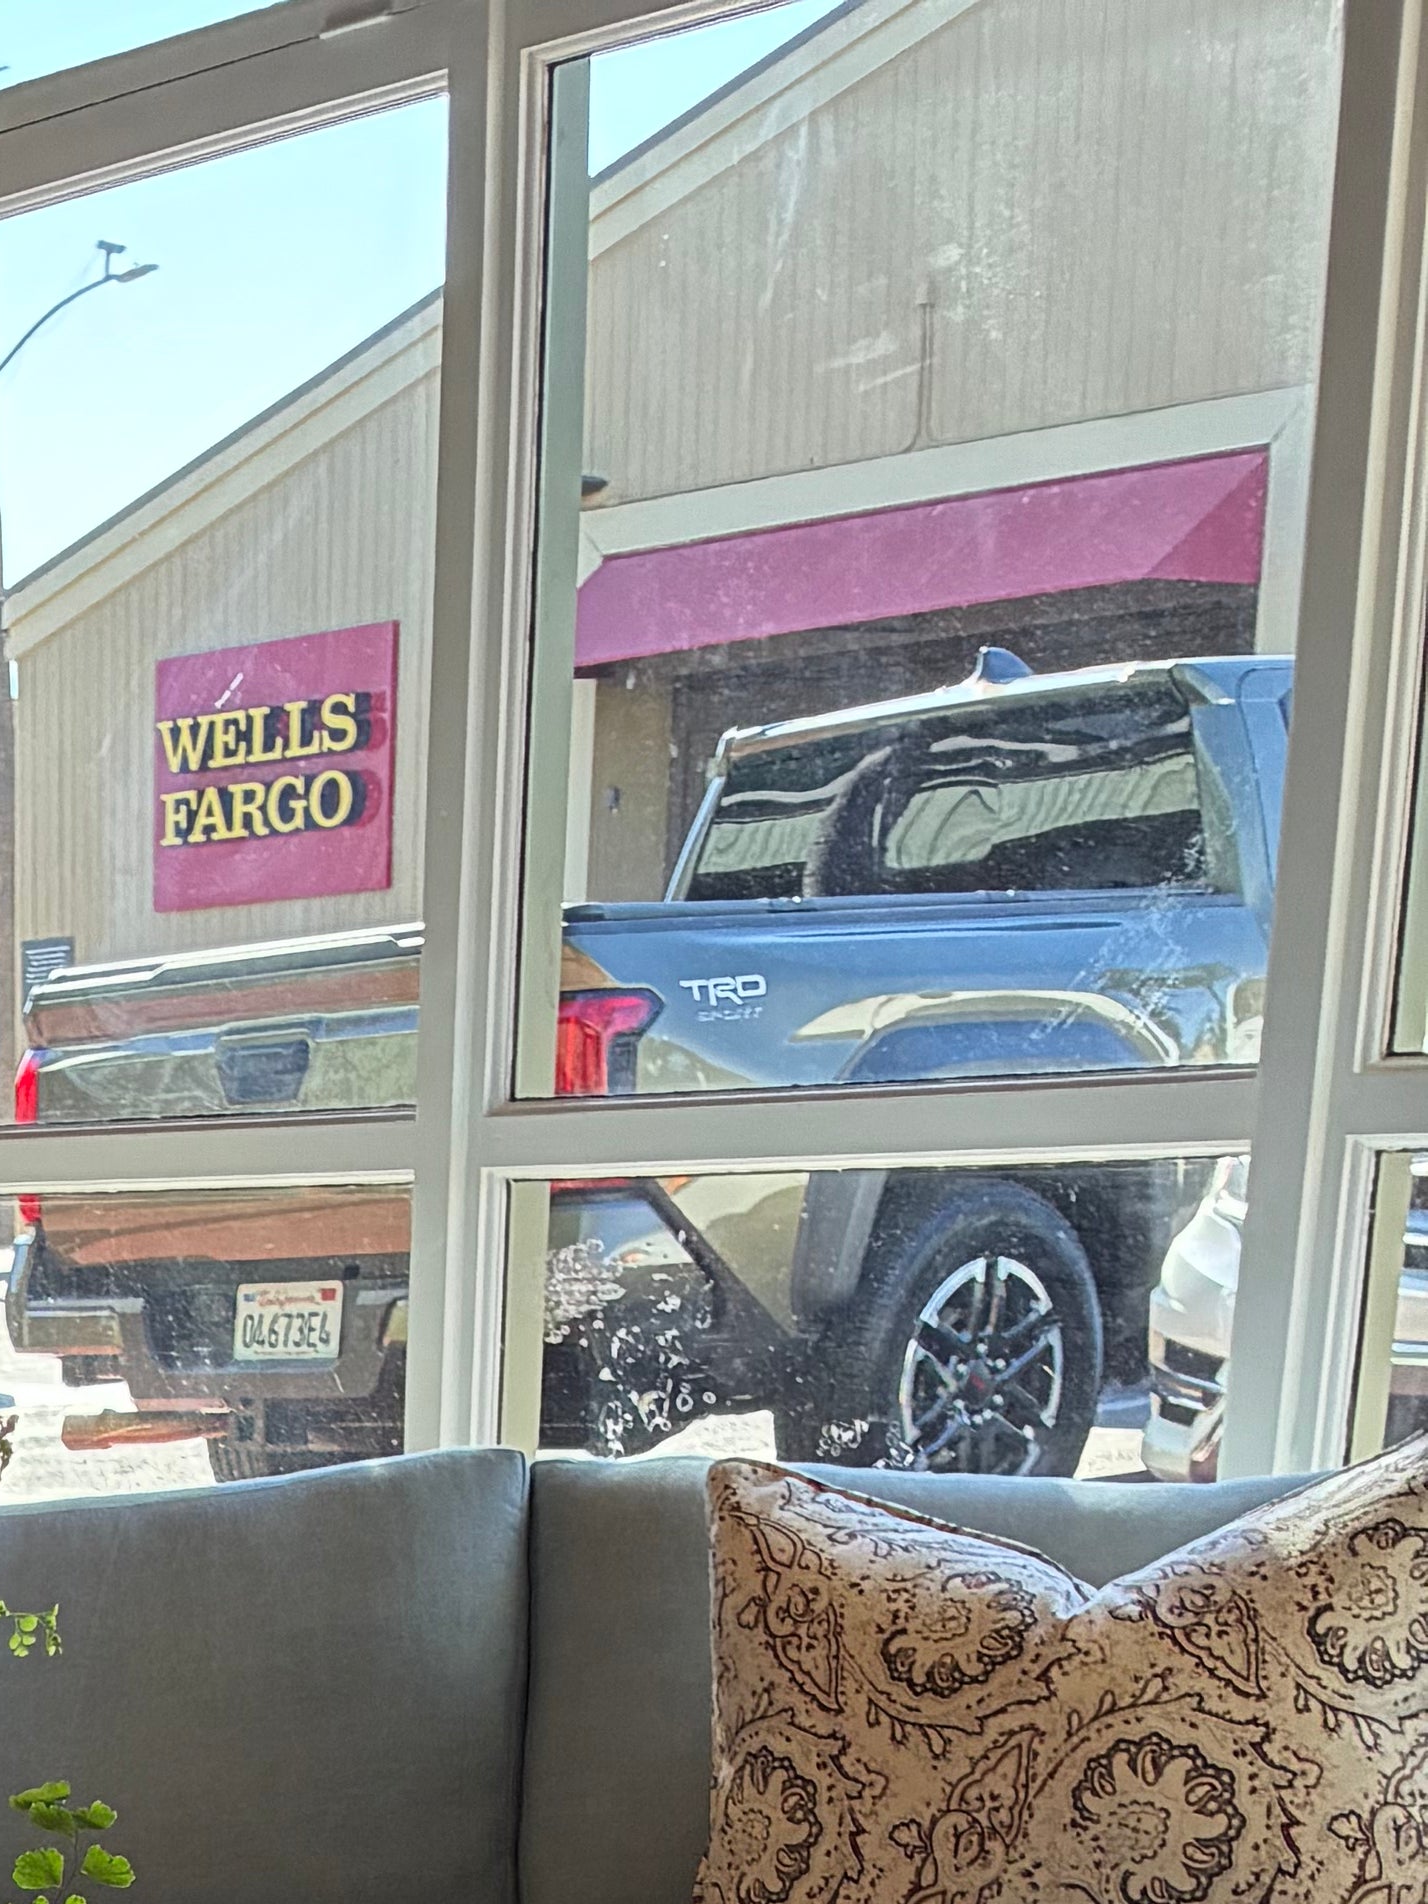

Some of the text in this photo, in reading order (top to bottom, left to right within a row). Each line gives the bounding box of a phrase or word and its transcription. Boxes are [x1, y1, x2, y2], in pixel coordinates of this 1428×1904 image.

[155, 692, 359, 774] WELLS
[159, 769, 354, 847] FARGO
[678, 973, 767, 1007] TRD
